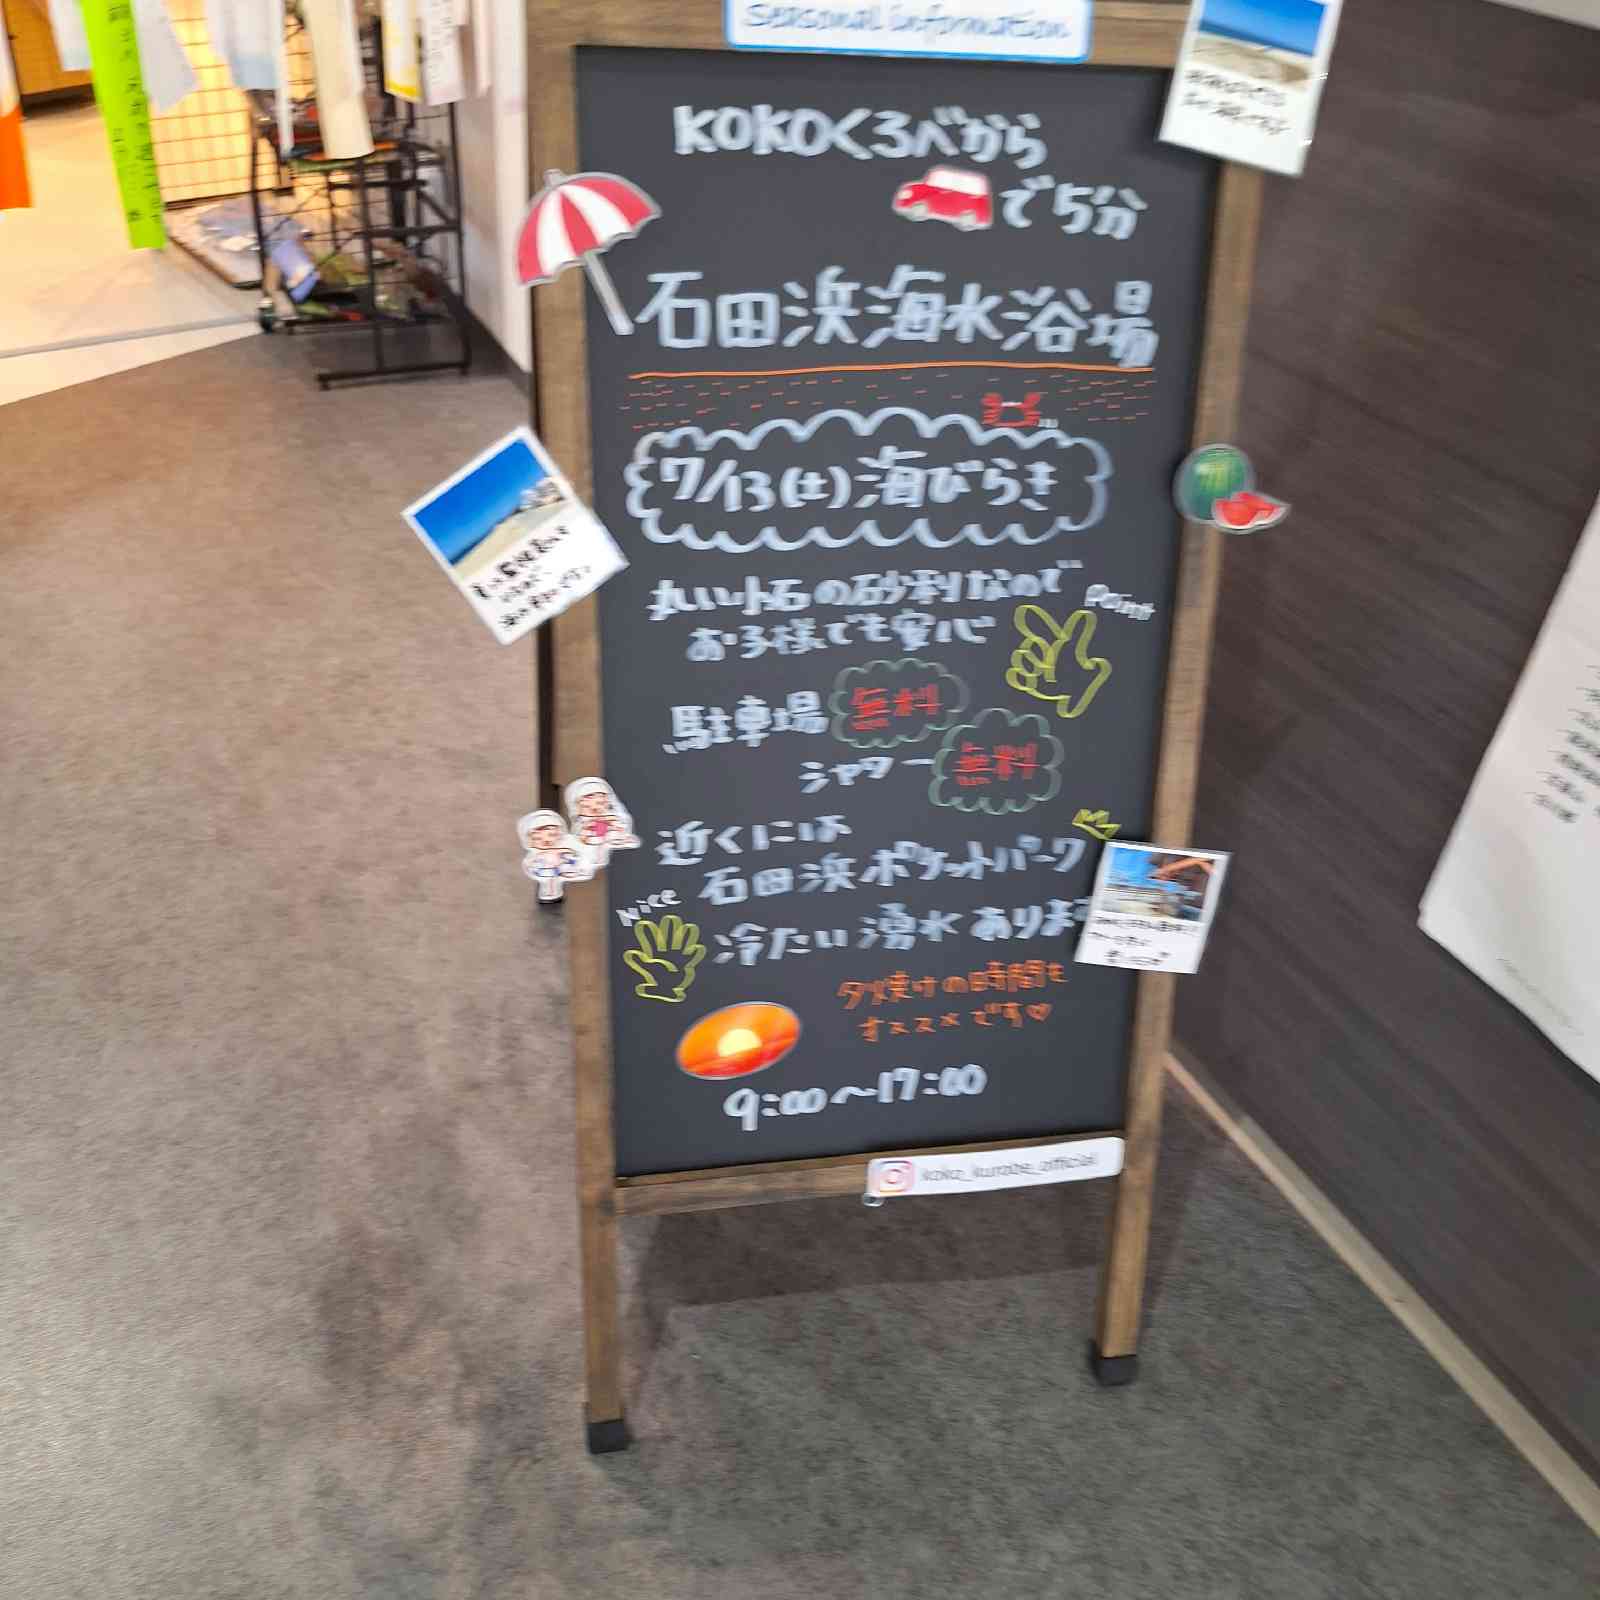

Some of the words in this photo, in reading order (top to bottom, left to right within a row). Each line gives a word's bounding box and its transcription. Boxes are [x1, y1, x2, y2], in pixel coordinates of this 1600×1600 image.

[743, 1, 883, 31] Seasonal
[889, 2, 1072, 44] information
[999, 175, 1148, 240] で5分
[636, 264, 1158, 368] 石田浜海水浴場
[648, 559, 1083, 620] 丸い小石の砂利なので
[686, 609, 996, 661] お子様でも安心
[663, 690, 829, 753] 駐車場
[850, 684, 942, 730] 無料
[798, 756, 936, 794] シャワー
[953, 742, 1039, 786] 無料
[656, 815, 853, 866] 近くには
[699, 834, 1086, 905] 石田浜ポケットパーク
[616, 889, 682, 926] Nice
[837, 960, 1068, 1009] 夕焼けの時間も
